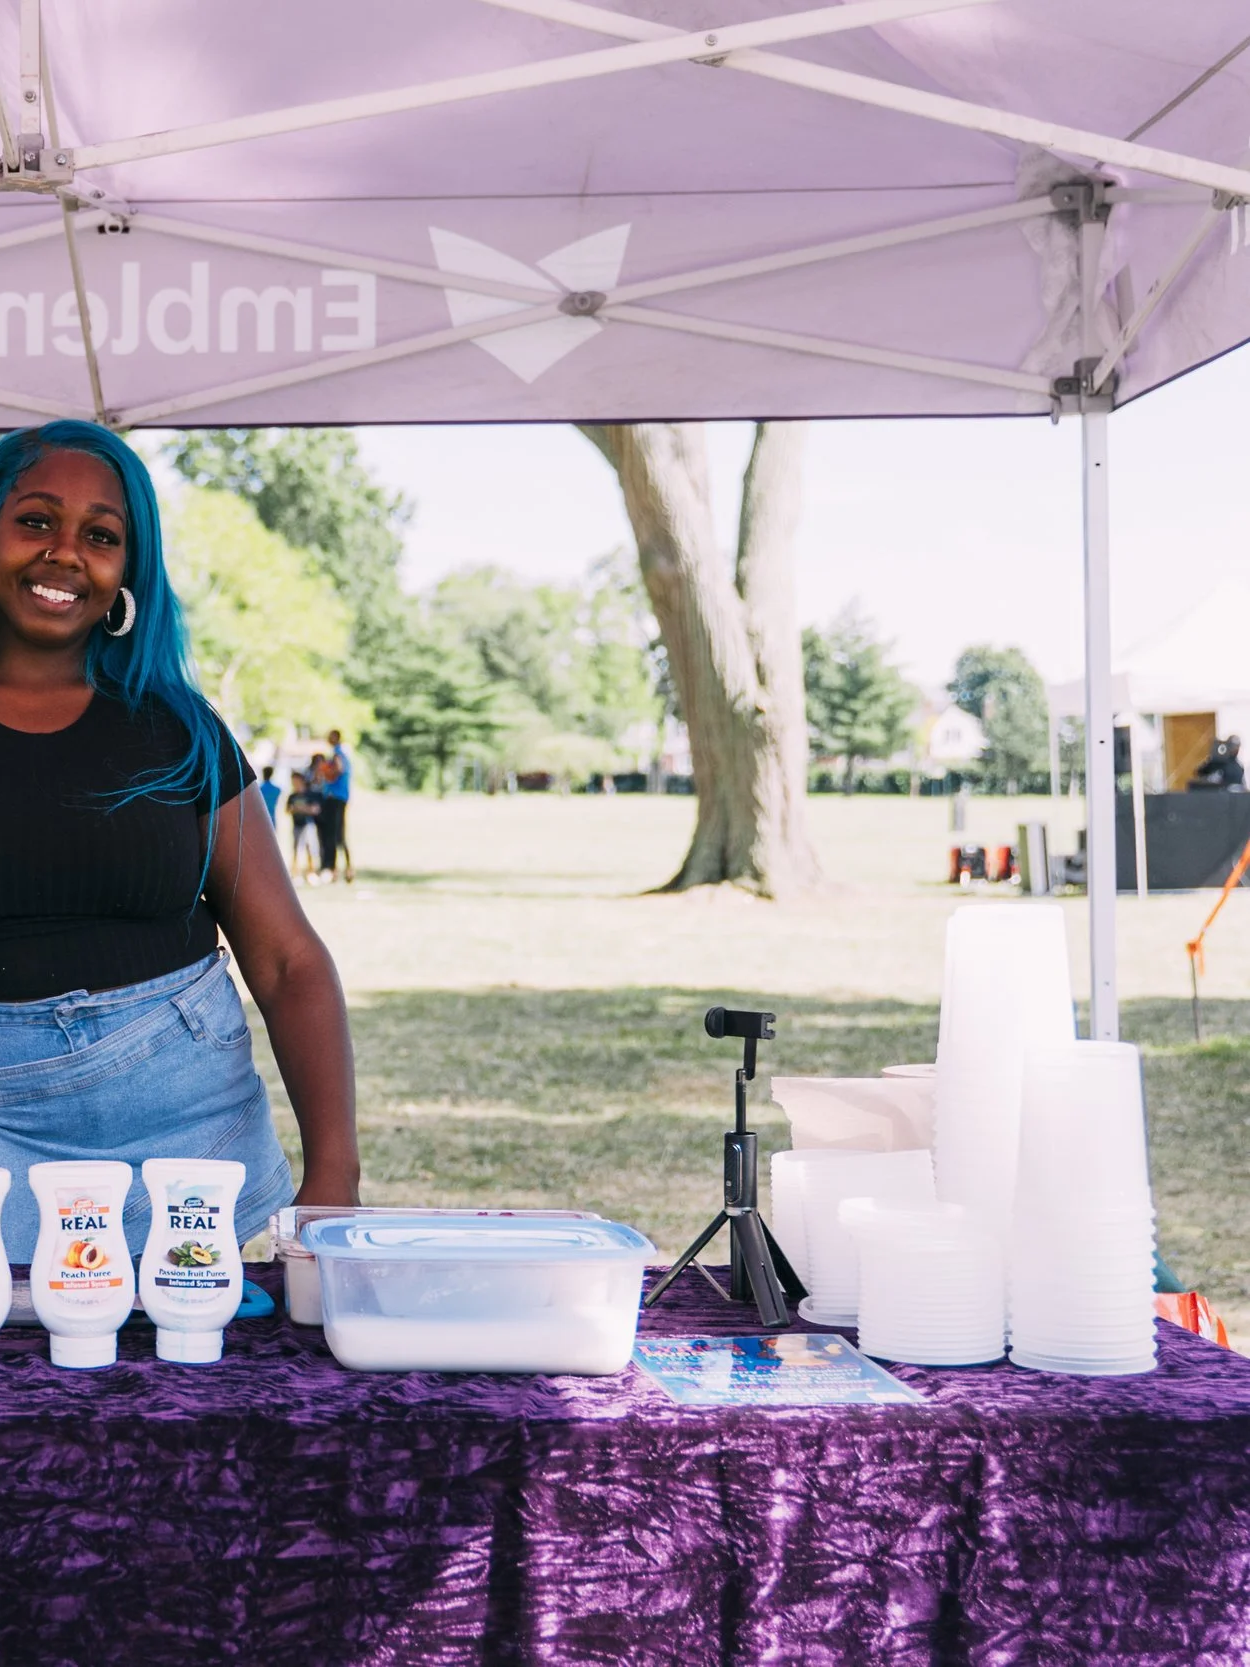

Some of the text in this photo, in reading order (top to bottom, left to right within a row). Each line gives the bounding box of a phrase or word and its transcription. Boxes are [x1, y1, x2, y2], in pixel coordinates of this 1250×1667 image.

[61, 1270, 111, 1279] Peach Puree
[159, 1268, 186, 1276] Passion
[169, 1279, 216, 1288] Infused Syrup
